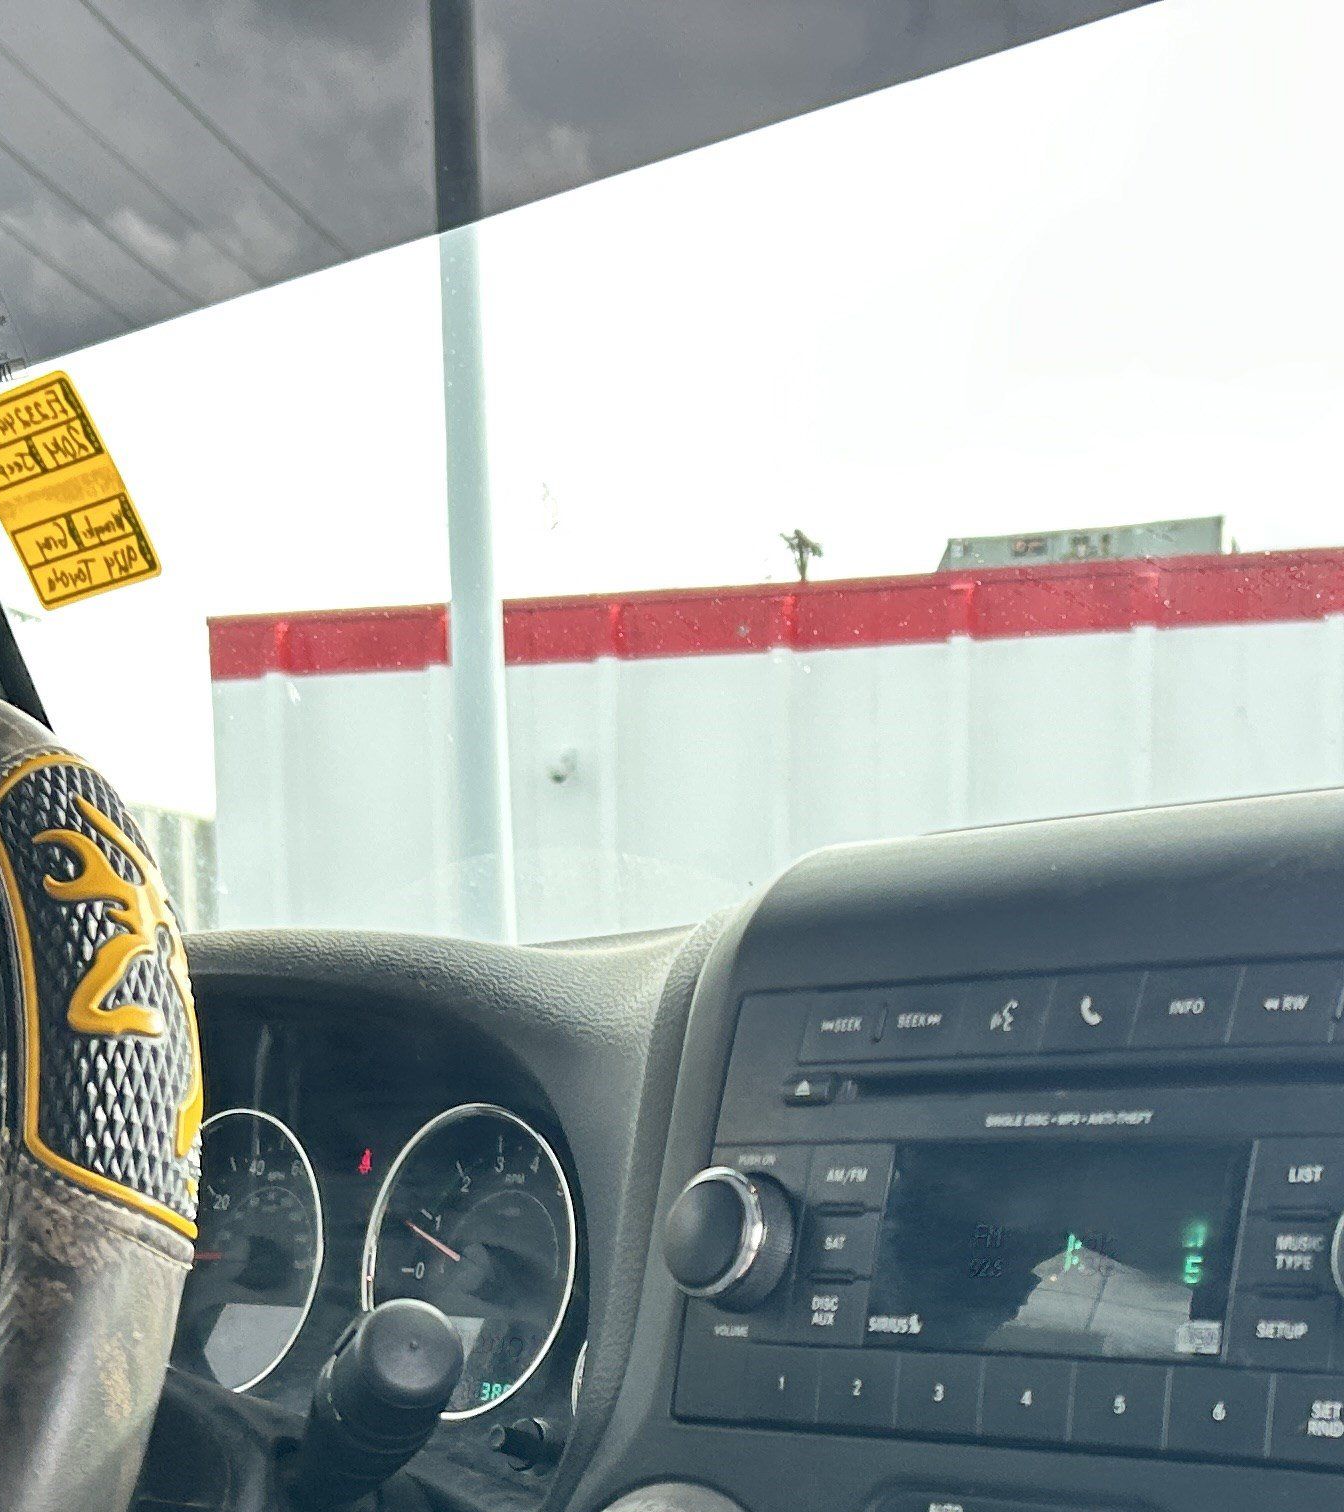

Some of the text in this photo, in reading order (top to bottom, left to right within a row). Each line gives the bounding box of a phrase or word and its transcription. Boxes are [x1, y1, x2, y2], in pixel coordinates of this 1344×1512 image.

[1169, 997, 1205, 1015] INFO
[1282, 995, 1309, 1011] RW
[249, 1160, 265, 1176] 40
[494, 1156, 505, 1173] 3
[826, 1167, 868, 1185] AM/FM
[1288, 1165, 1324, 1183] LIST
[461, 1175, 471, 1193] 2
[213, 1194, 230, 1210] 20
[434, 1214, 442, 1232] 1
[825, 1235, 846, 1250] SAT
[1276, 1234, 1324, 1251] MUSIC
[415, 1261, 425, 1280] 0
[1276, 1254, 1313, 1270] TYPE
[811, 1295, 839, 1311] DISC
[811, 1312, 835, 1326] AUX
[1256, 1320, 1308, 1339] SETUP
[778, 1375, 785, 1391] 1
[853, 1378, 862, 1395] 2
[933, 1383, 945, 1402] 3
[1020, 1389, 1032, 1407] 4
[1113, 1394, 1125, 1415] 5
[1212, 1401, 1226, 1421] 6
[1311, 1401, 1343, 1419] SET
[1307, 1419, 1344, 1438] RND
